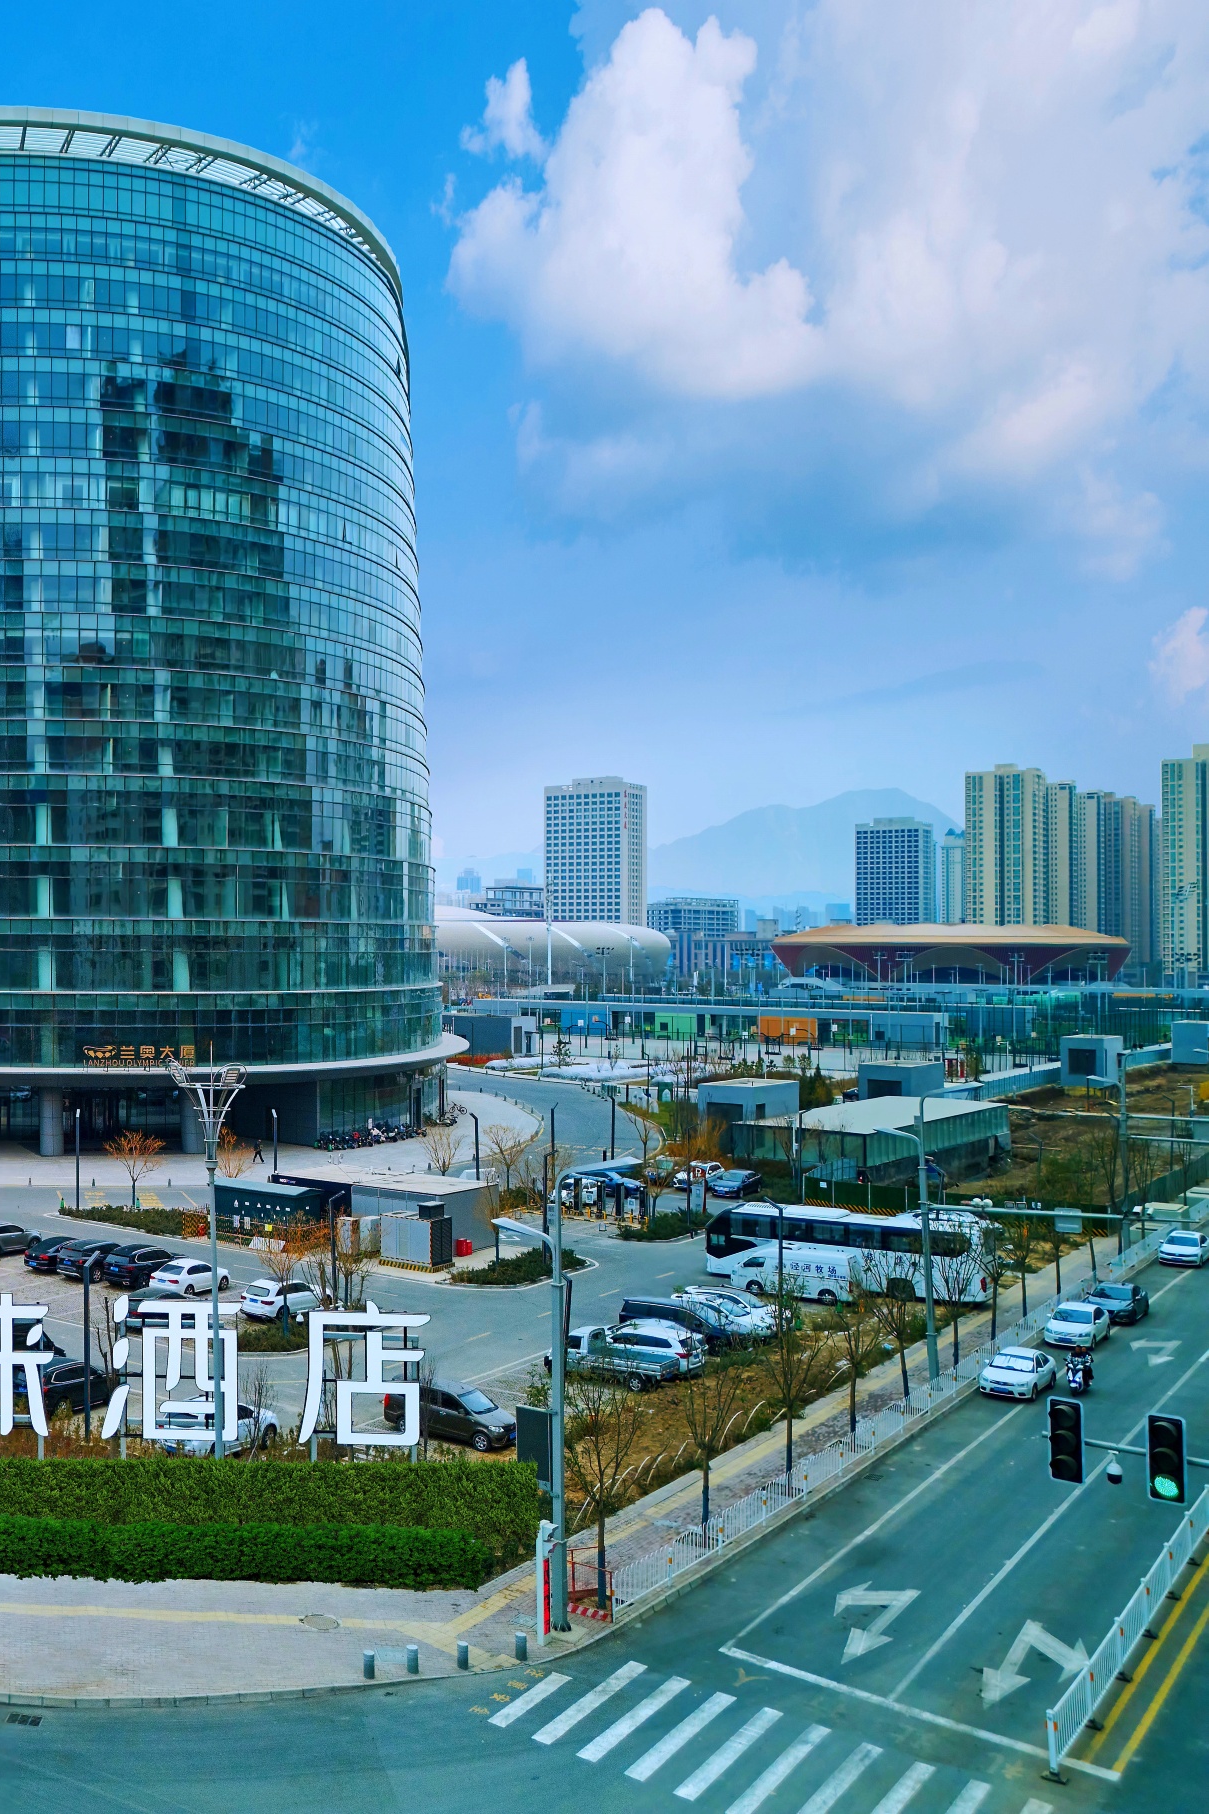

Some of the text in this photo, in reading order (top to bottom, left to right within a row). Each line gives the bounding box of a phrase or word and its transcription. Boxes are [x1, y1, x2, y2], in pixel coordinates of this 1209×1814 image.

[119, 1045, 195, 1059] 兰奥大厦
[83, 1059, 124, 1067] LANZHOU
[126, 1059, 164, 1067] OLYMPIC
